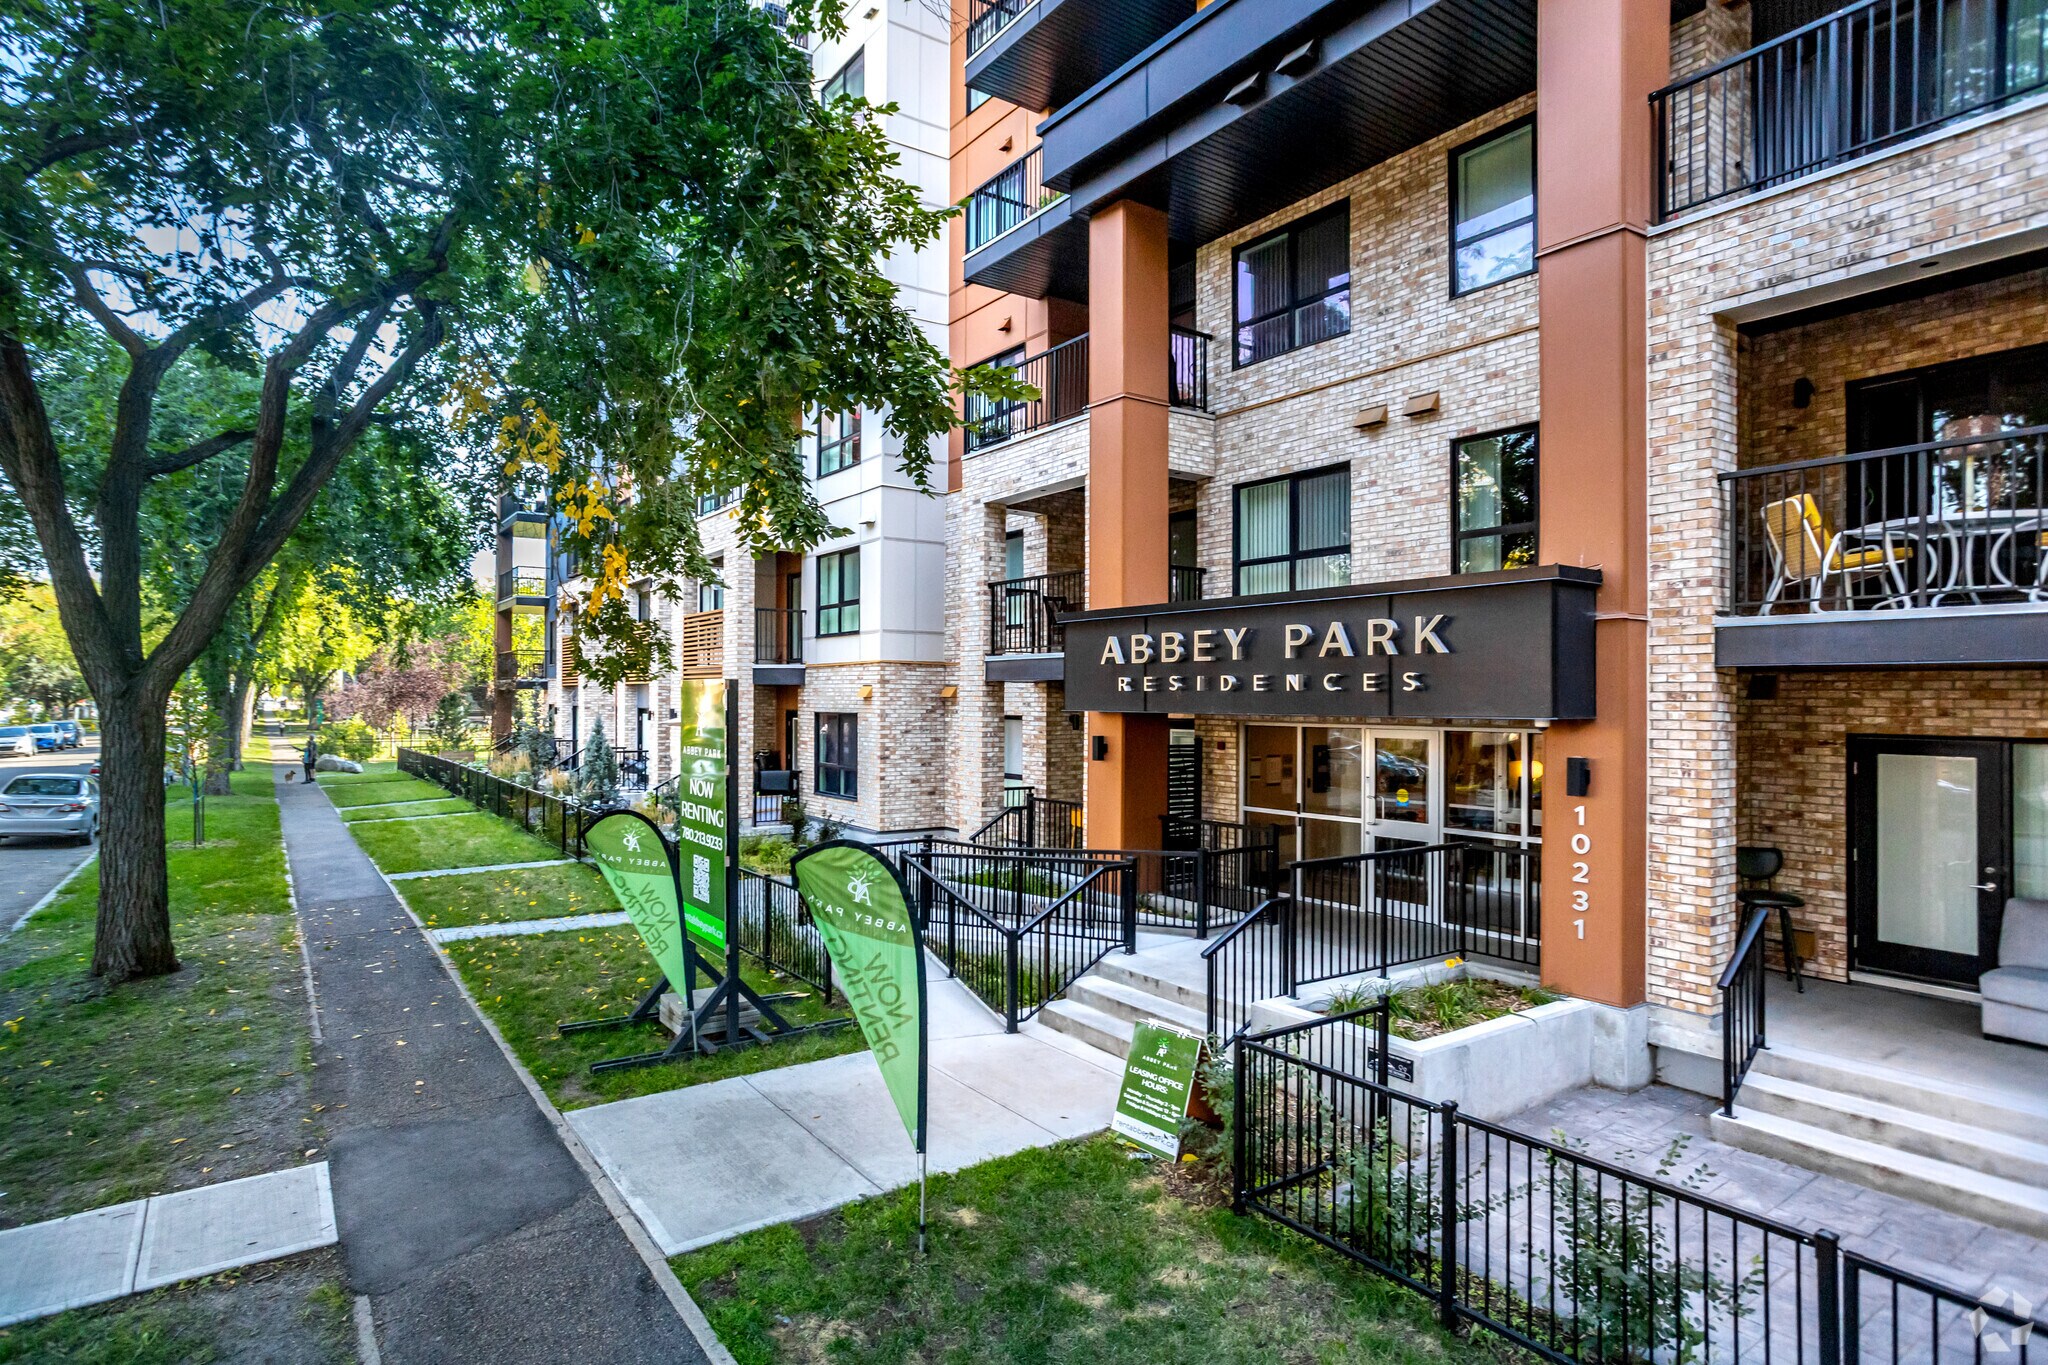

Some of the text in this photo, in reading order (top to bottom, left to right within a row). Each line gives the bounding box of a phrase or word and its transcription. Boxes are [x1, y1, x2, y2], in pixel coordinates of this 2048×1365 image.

[1100, 614, 1450, 665] ABBEY PARK
[1117, 672, 1422, 692] RESIDENCES
[682, 746, 722, 759] ABBEY PARK
[689, 778, 714, 799] NOW
[681, 800, 724, 828] RENTING
[1570, 805, 1591, 940] 10231
[1142, 1055, 1161, 1065] ABBEY
[1129, 1065, 1158, 1081] LEASING
[1158, 1076, 1184, 1091] OFFICE
